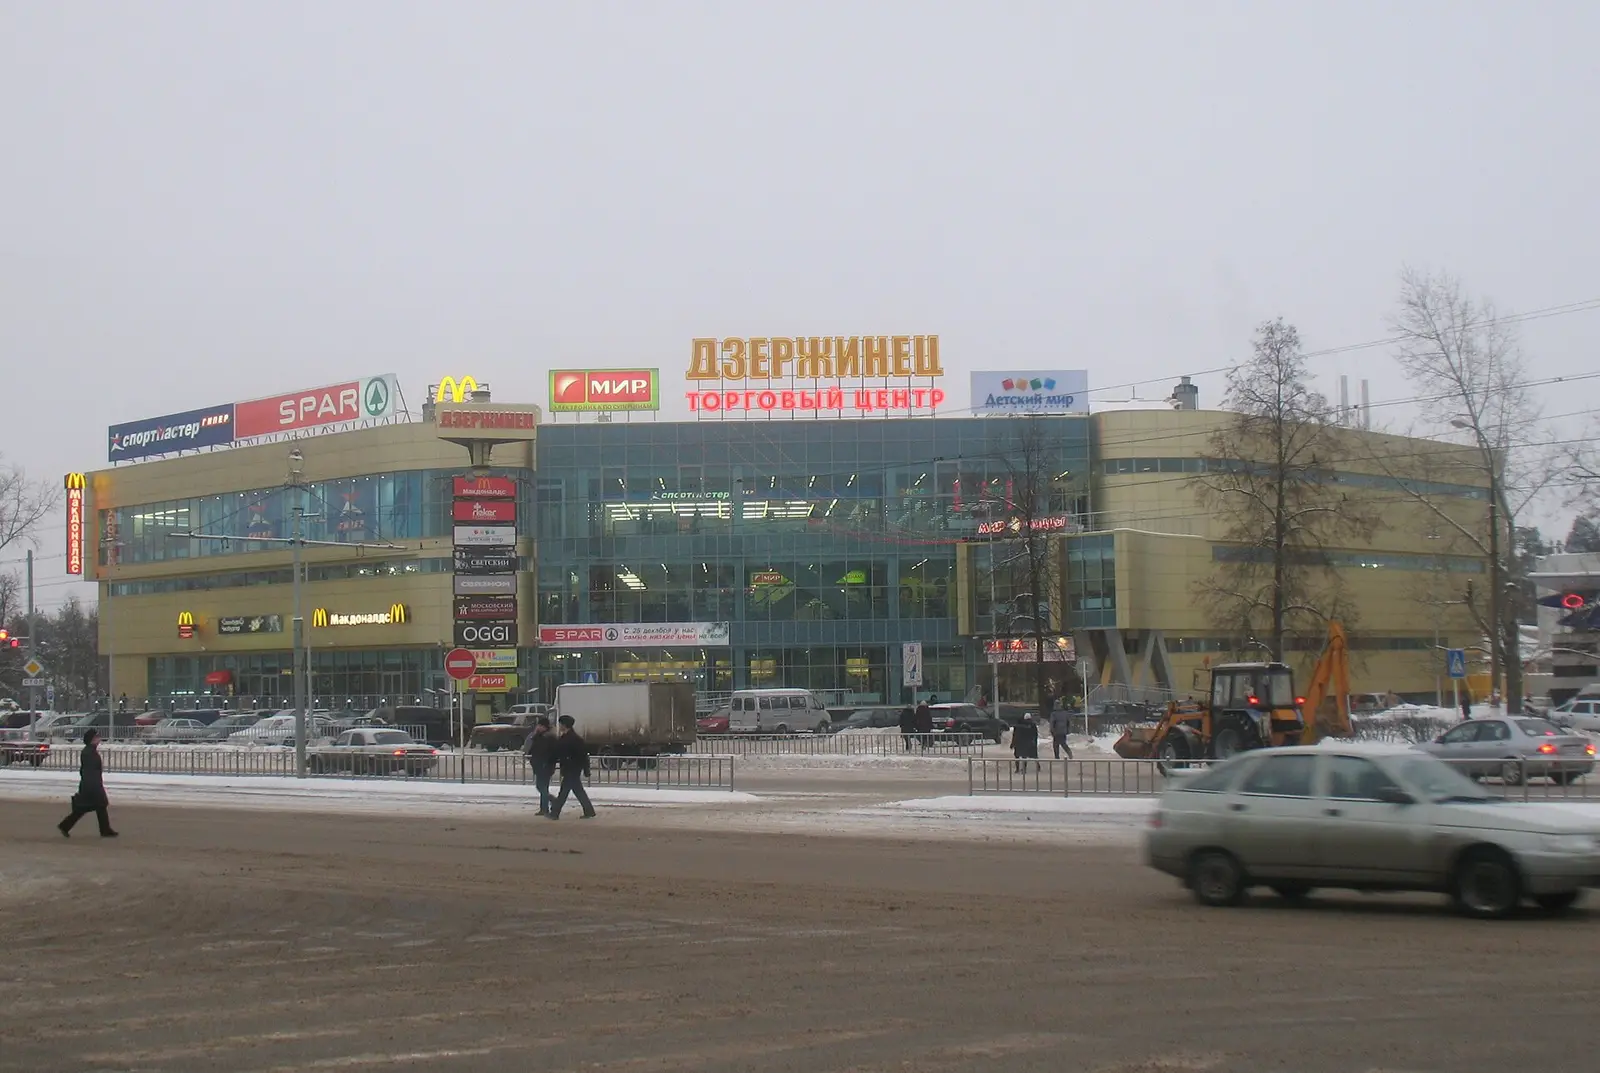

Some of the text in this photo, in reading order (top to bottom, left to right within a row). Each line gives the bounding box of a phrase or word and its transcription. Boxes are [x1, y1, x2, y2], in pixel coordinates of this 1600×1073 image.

[686, 335, 944, 380] ДЗЕРЖИНЕЦ
[278, 388, 358, 425] SPAR
[686, 387, 945, 412] ТОРГОВЫЙ ЦЕНТР
[985, 393, 1074, 408] Детский мир
[202, 413, 229, 426] ГИПЕР
[439, 410, 535, 429] ДЗЕРЖИНЕЦ
[122, 422, 200, 447] спортмастер
[69, 489, 81, 573] Макдоналдс
[330, 612, 391, 625] Макдоналдс
[463, 626, 509, 642] OGGI
[555, 630, 601, 640] SPAR
[643, 627, 671, 635] декабря
